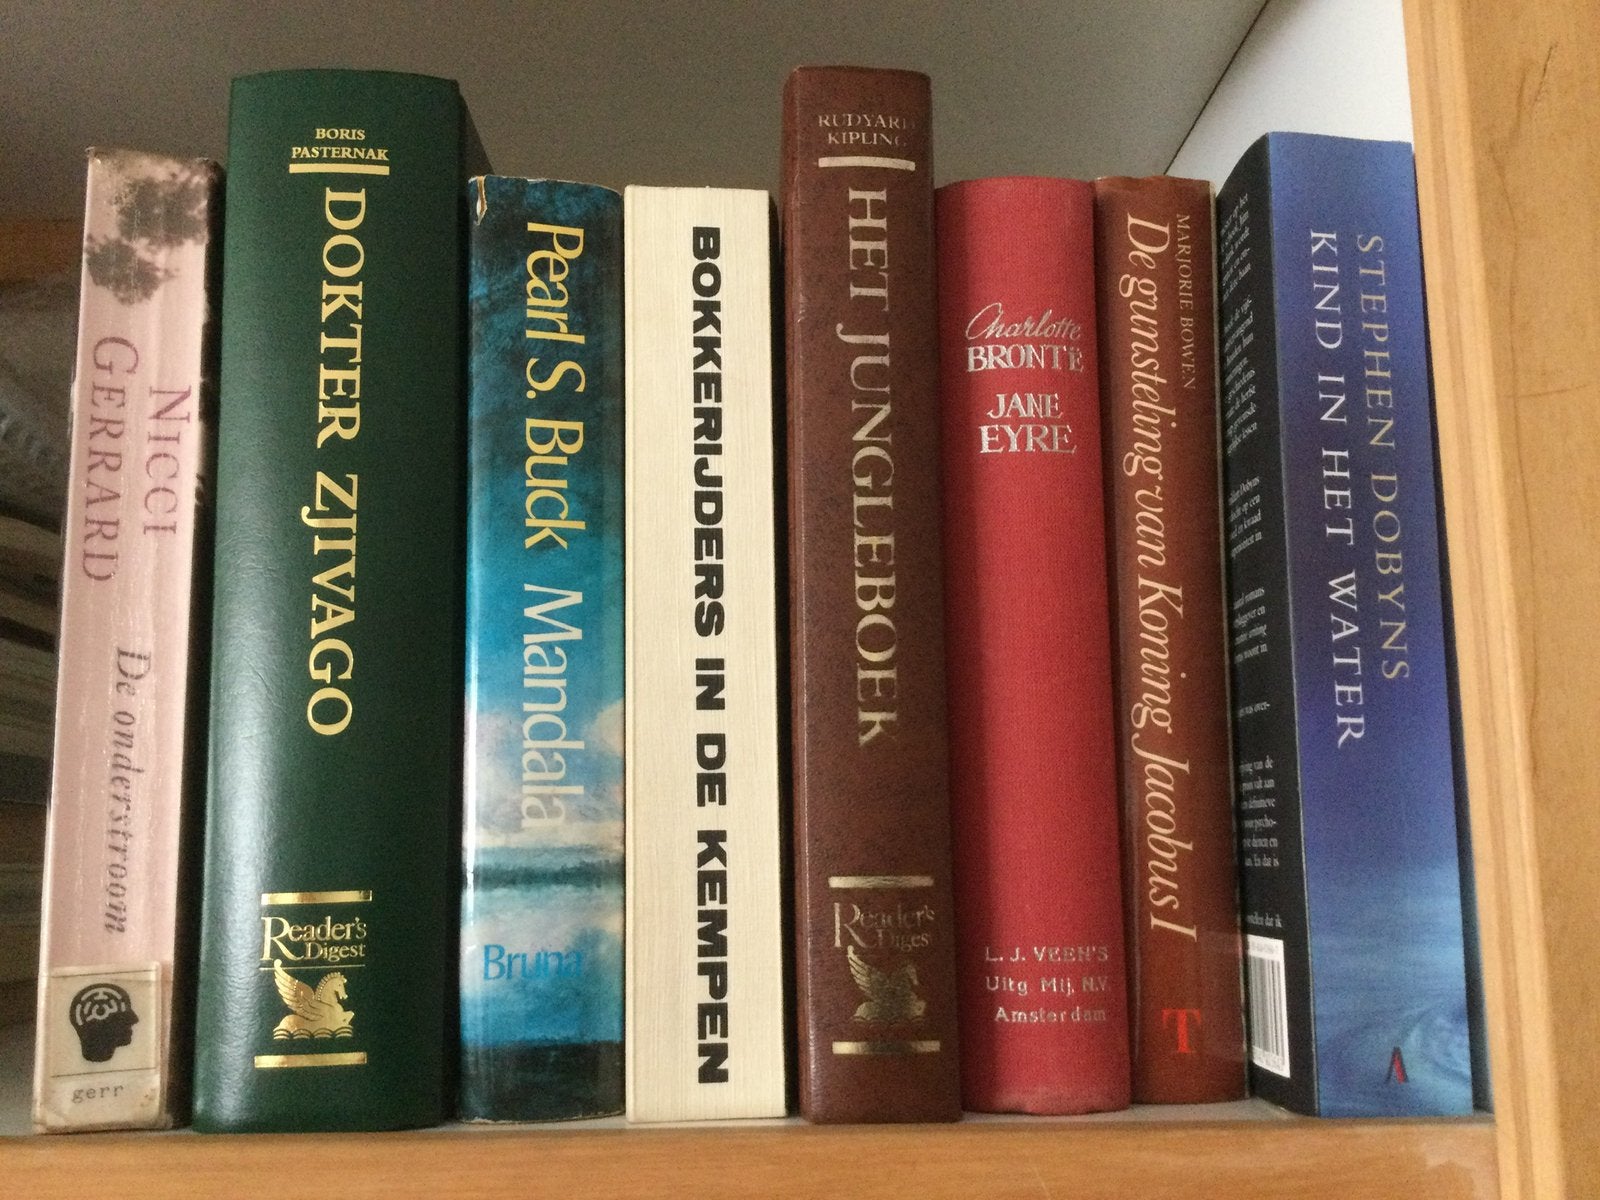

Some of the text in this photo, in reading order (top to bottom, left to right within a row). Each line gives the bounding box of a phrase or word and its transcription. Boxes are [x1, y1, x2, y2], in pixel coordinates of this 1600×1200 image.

[291, 146, 390, 161] PASTERNAK
[315, 128, 366, 141] BORIS
[965, 302, 1081, 341] Charlotte
[1175, 213, 1196, 391] MARJORIE BOWEN
[986, 392, 1063, 419] JANE
[83, 337, 139, 582] GERRARD
[144, 385, 192, 535] NICCI
[301, 187, 366, 736] DOKTER ZJIVAGO
[978, 424, 1078, 454] EYRE
[1357, 233, 1410, 680] STEPHEN DOBYNS
[836, 186, 899, 747] HET JUNGLEBOEK
[1310, 229, 1366, 749] KIND IN HET WATER
[521, 222, 586, 829] Pearl S. Buck Mandala
[1119, 211, 1198, 942] De gunsteling van Koning Jacobus I
[692, 226, 729, 1084] BOKKERIJDERS IN DE KEMPEN
[104, 647, 150, 935] De onderstroom
[261, 916, 367, 961] Reader's
[304, 941, 366, 962] Digest
[876, 928, 932, 953] Diges
[985, 946, 1004, 963] L.
[1010, 946, 1026, 962] J.
[483, 943, 583, 981] Bruna
[995, 1005, 1106, 1023] Amsterdam
[1162, 1007, 1201, 1053] T
[72, 1083, 124, 1105] gerr
